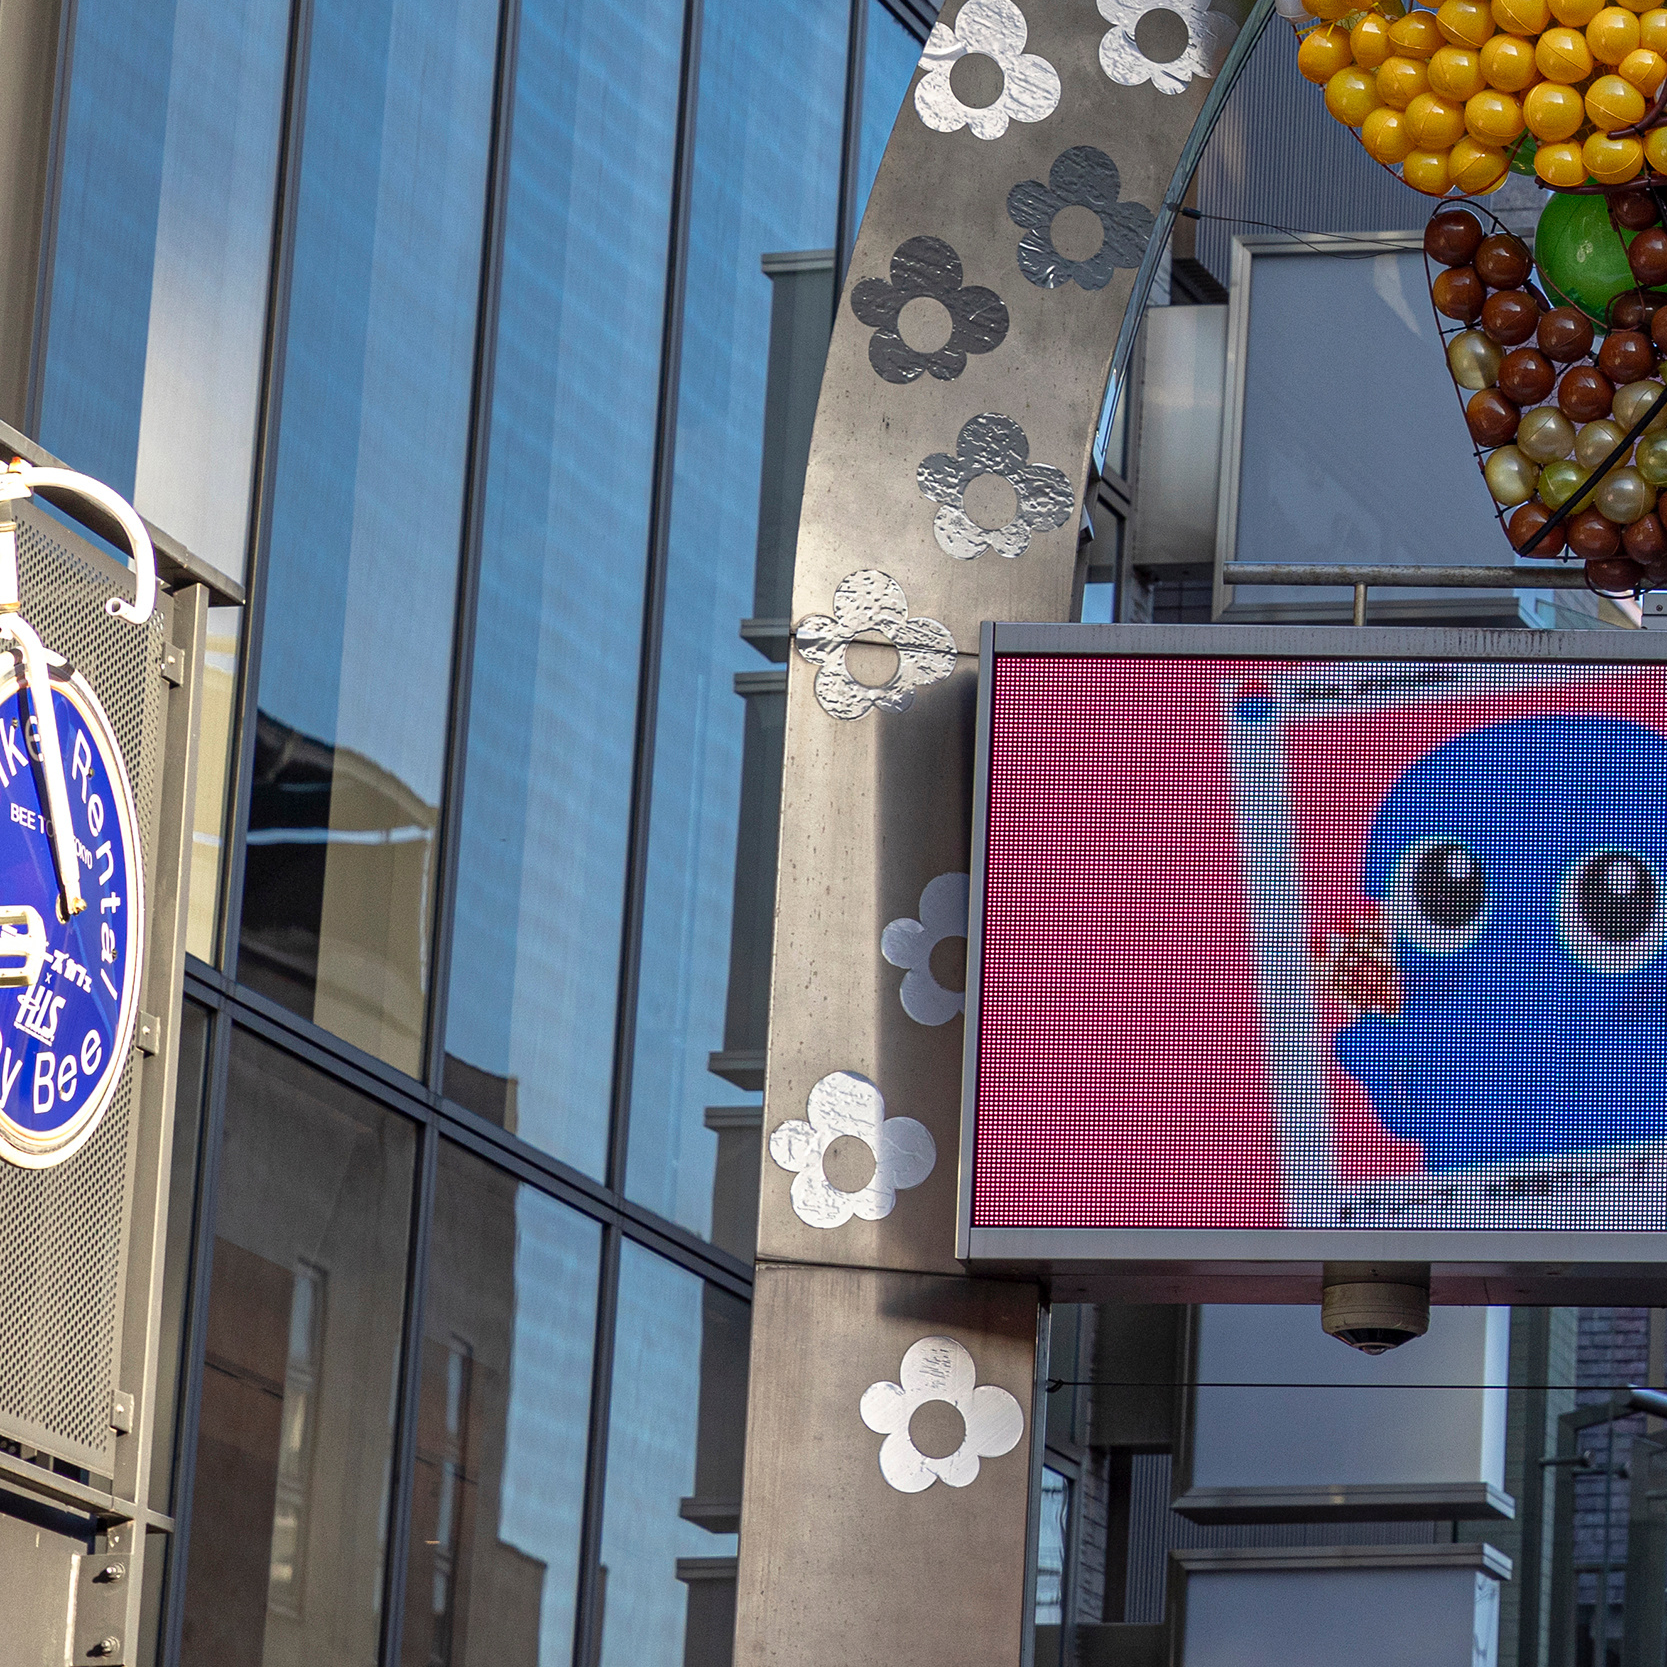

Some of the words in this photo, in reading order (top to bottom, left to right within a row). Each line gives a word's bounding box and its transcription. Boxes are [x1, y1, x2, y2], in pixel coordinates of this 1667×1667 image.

[10, 802, 36, 831] BEE
[71, 728, 121, 1000] Rental
[32, 1028, 102, 1115] Bee
